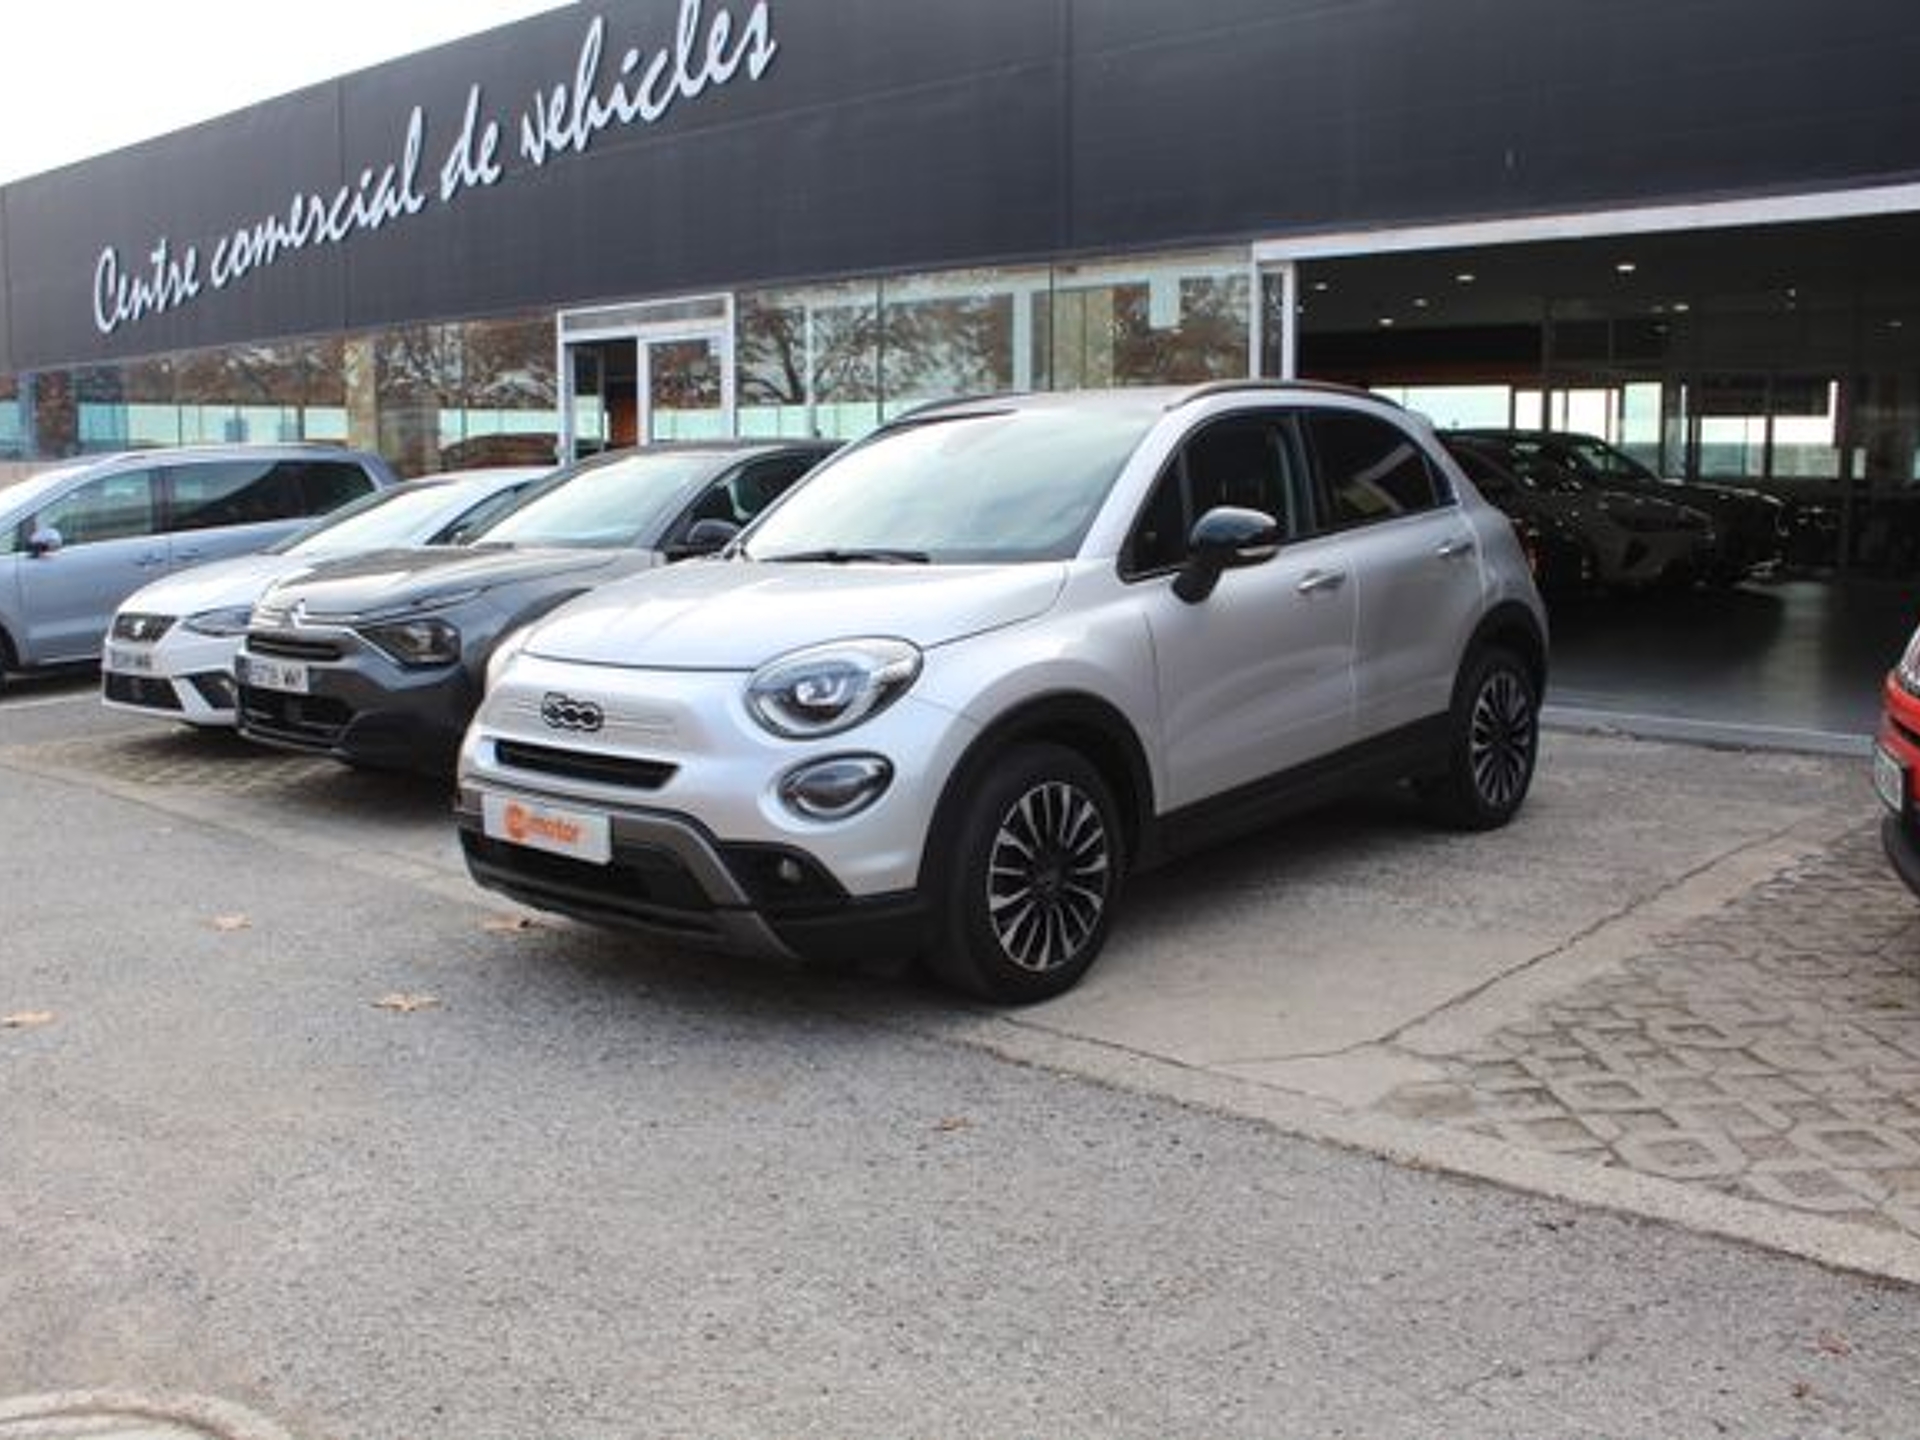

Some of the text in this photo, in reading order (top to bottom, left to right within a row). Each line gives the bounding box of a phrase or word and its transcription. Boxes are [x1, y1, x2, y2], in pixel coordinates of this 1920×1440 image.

[95, 0, 776, 333] Centre comercial de vehicles
